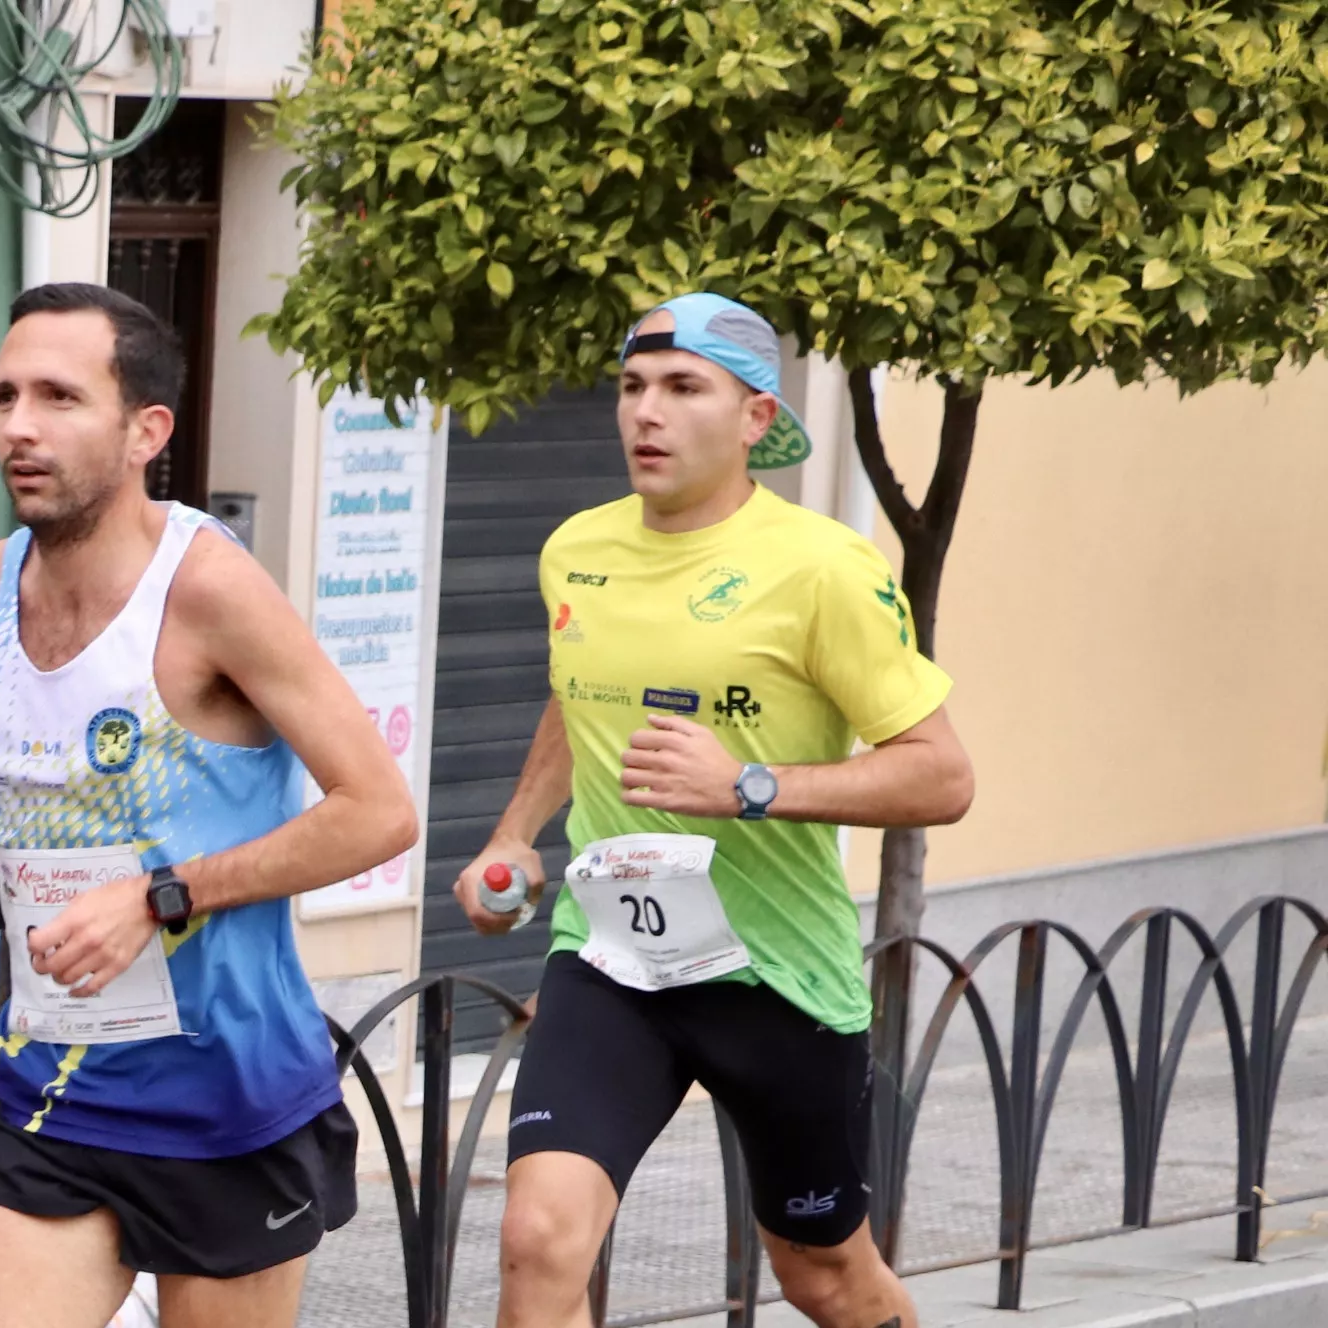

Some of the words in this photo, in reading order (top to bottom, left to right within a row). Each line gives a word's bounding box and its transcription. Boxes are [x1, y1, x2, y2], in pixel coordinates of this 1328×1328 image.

[578, 689, 590, 701] EL
[592, 691, 633, 707] MONTE
[714, 717, 762, 729] RIADA
[619, 894, 666, 937] 20
